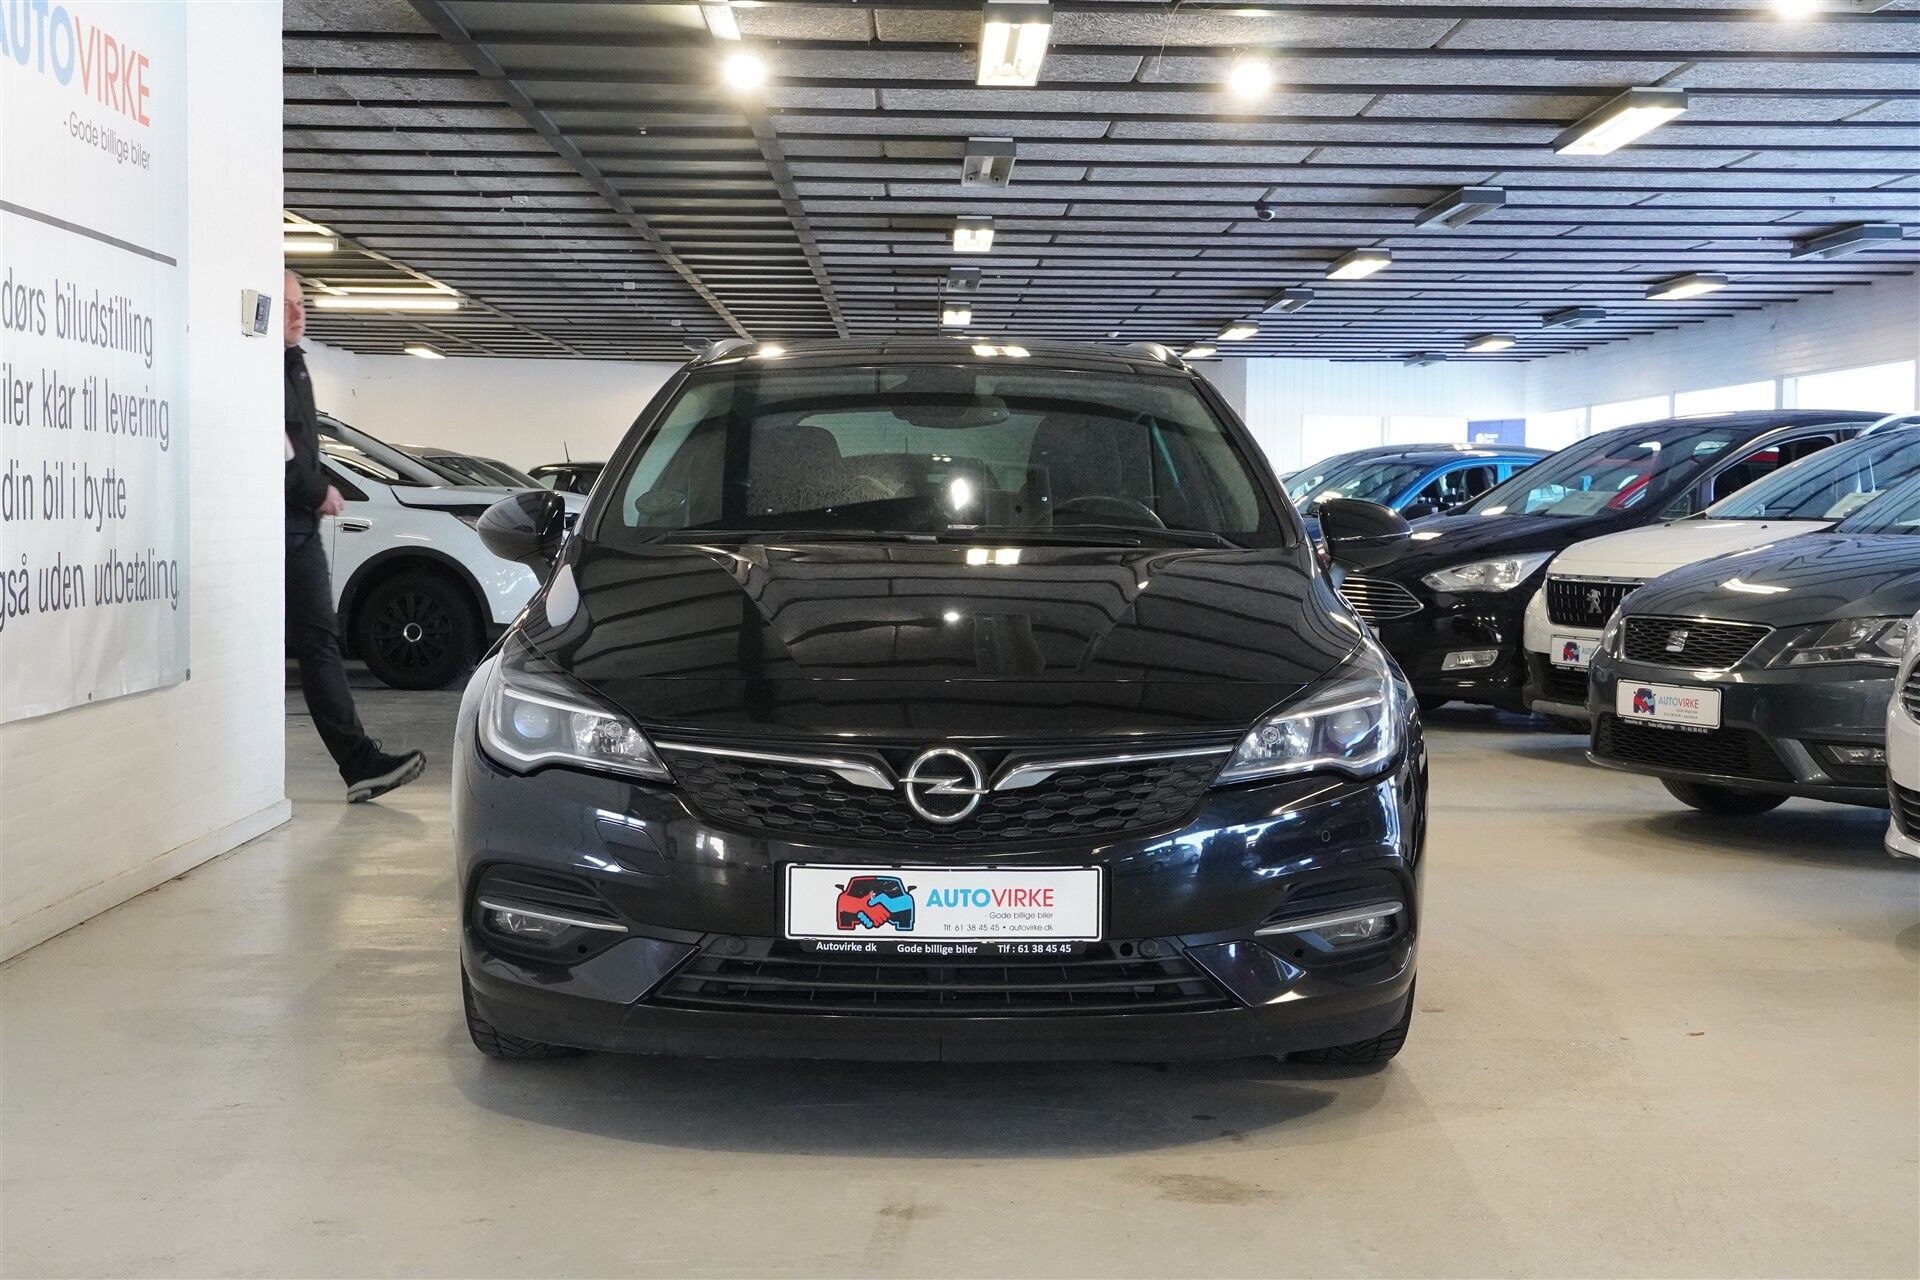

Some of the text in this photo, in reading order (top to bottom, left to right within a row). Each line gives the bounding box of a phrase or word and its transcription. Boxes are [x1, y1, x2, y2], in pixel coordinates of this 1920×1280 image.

[70, 111, 98, 147] Gode
[101, 124, 129, 164] billige
[131, 140, 150, 170] biler
[2, 267, 153, 369] dørs biludstilling
[2, 362, 169, 451] iler klar til levering
[2, 459, 127, 532] din bil i bytte
[39, 552, 86, 613] uden
[1658, 695, 1699, 709] AUTOVIRKE
[926, 888, 1054, 908] AUTOVIRKE
[989, 911, 1012, 919] Gode
[1013, 911, 1036, 921] billige
[1037, 911, 1054, 919] biler
[954, 924, 964, 932] 61
[816, 941, 862, 952] Autovirke
[897, 943, 922, 953] Gode
[925, 944, 953, 955] billige
[955, 944, 978, 954] biler
[998, 944, 1011, 953] Tlf
[1017, 944, 1029, 953] 61
[1032, 944, 1043, 953] 38
[1045, 944, 1057, 953] 45
[1059, 944, 1072, 953] 45
